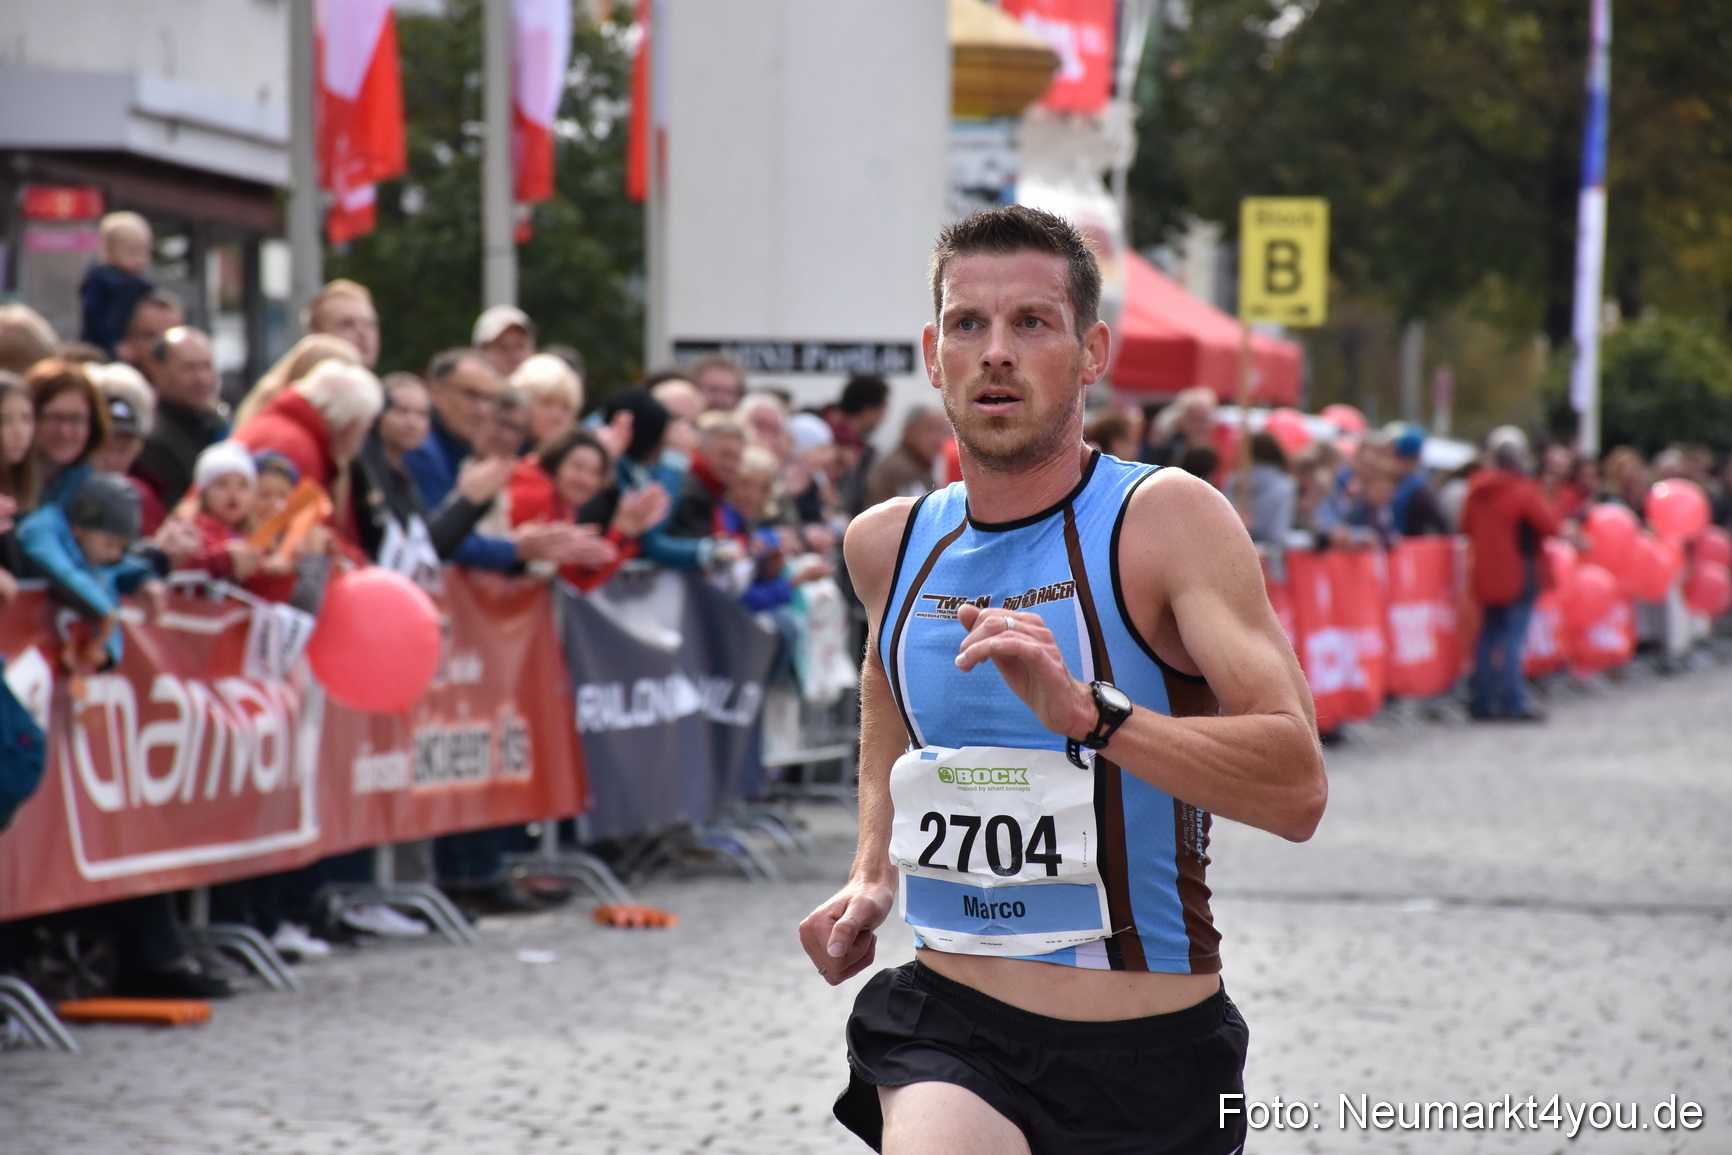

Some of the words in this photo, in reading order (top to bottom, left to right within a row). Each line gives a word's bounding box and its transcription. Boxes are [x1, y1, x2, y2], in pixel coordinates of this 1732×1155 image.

[1265, 238, 1303, 296] B
[1036, 580, 1076, 605] RACER
[955, 767, 1030, 785] BOCK
[1005, 785, 1031, 793] concepts
[918, 811, 1062, 877] 2704
[963, 895, 1026, 920] Marco
